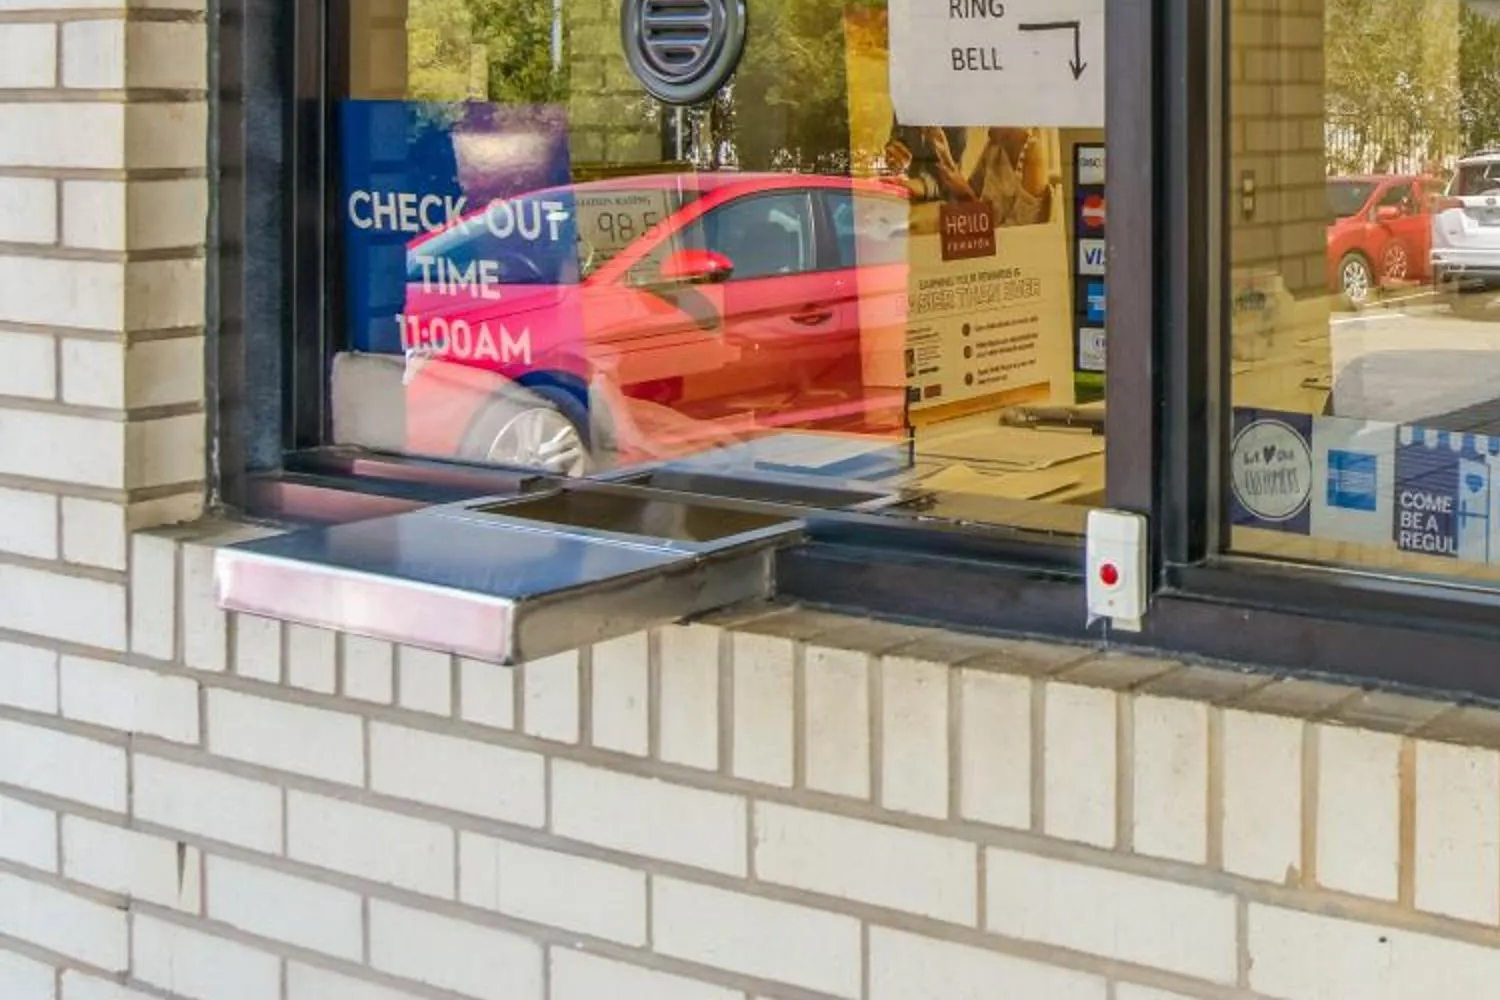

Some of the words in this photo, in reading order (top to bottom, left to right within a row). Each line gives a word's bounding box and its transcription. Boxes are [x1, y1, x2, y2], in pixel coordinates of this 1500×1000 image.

[951, 47, 1003, 71] BELL
[416, 256, 500, 299] TIME
[396, 313, 532, 365] 11:00AM
[1401, 491, 1452, 513] COME
[1401, 511, 1422, 530] BE
[1425, 514, 1438, 532] A
